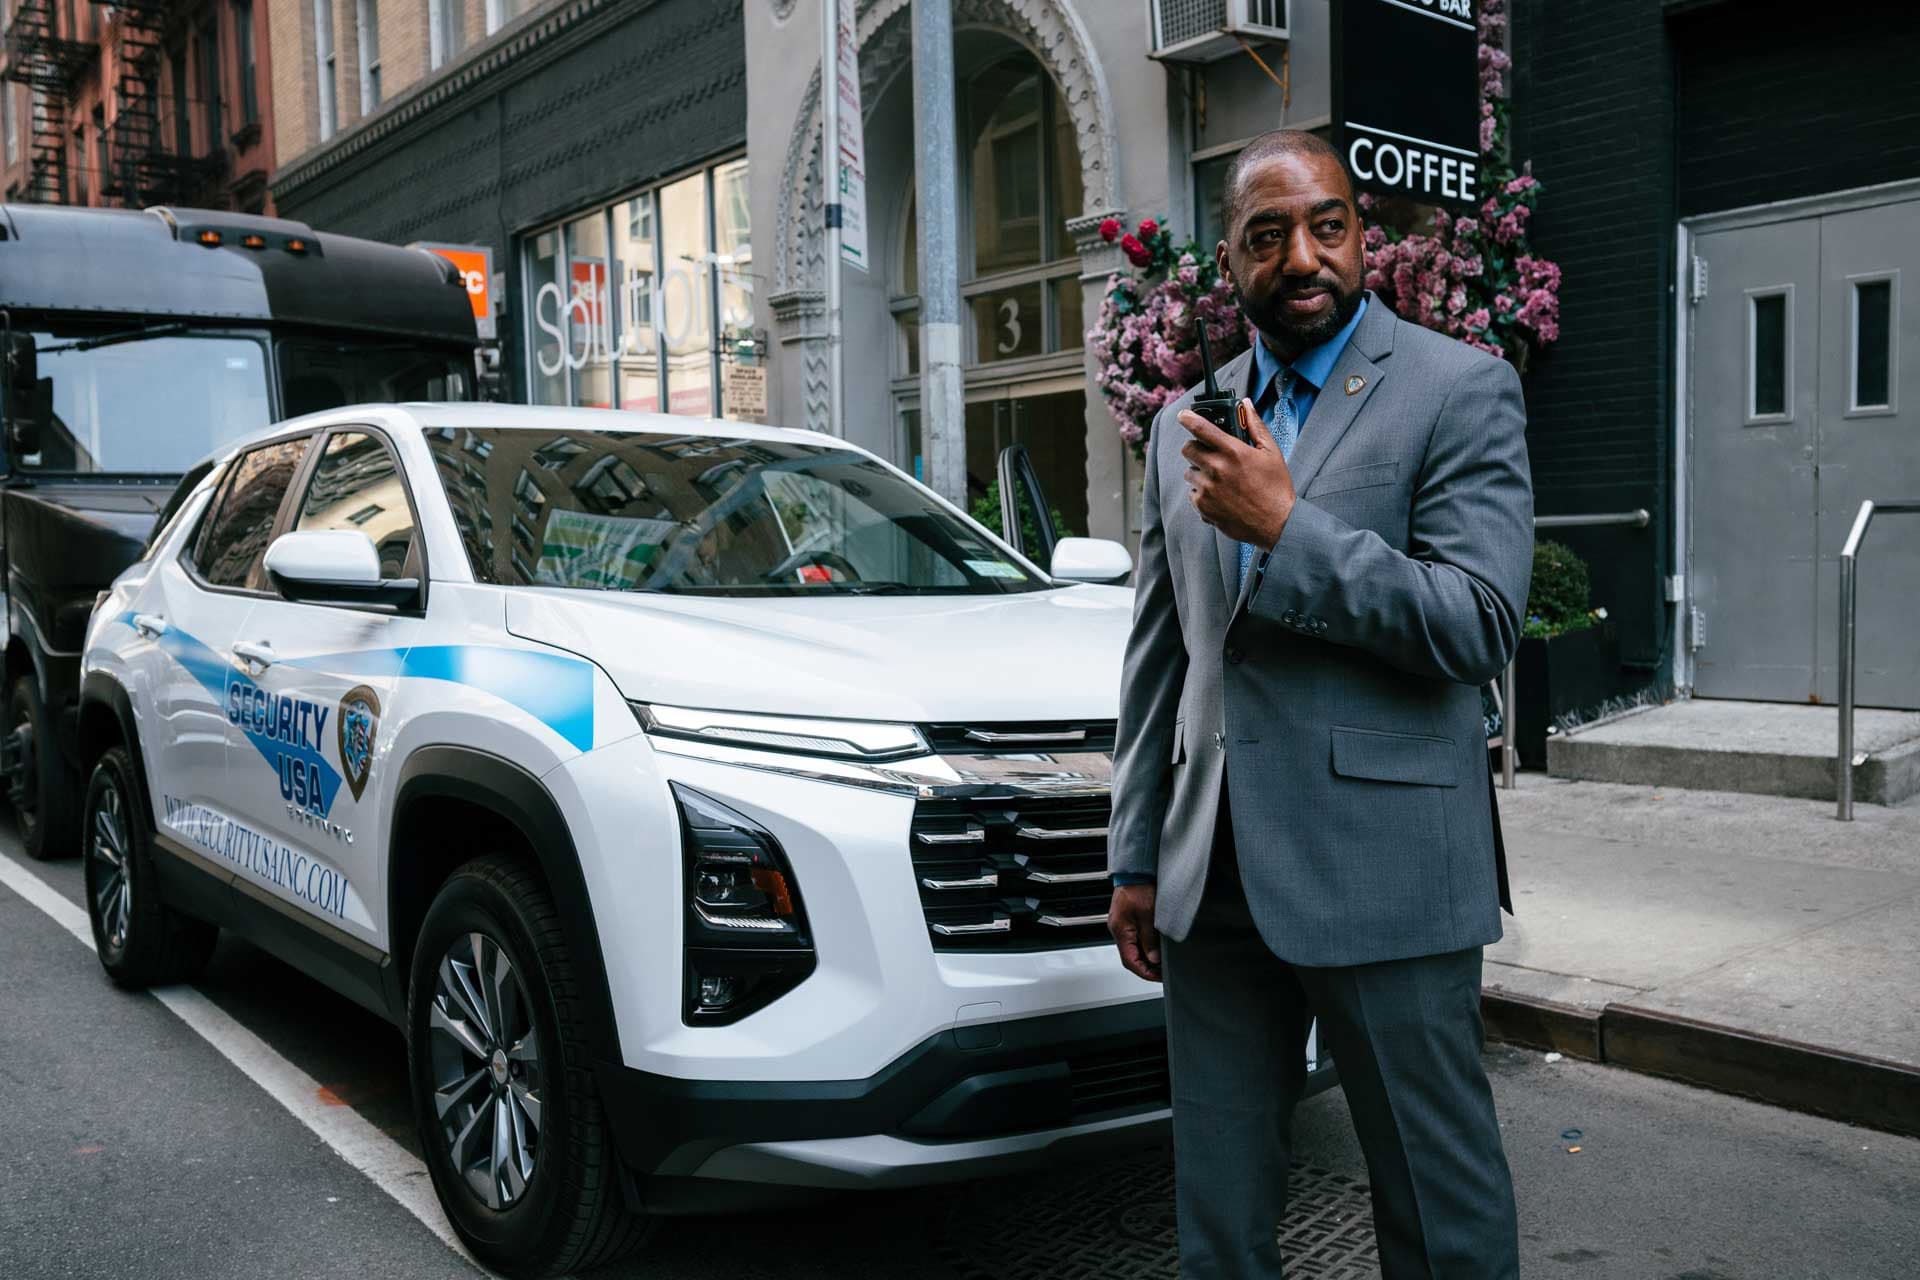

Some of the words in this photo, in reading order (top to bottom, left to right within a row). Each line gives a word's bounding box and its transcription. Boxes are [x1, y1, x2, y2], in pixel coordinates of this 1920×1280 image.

[1349, 138, 1476, 201] COFFEE
[997, 297, 1023, 354] 3
[228, 680, 330, 753] SECURITY
[277, 752, 326, 817] USA
